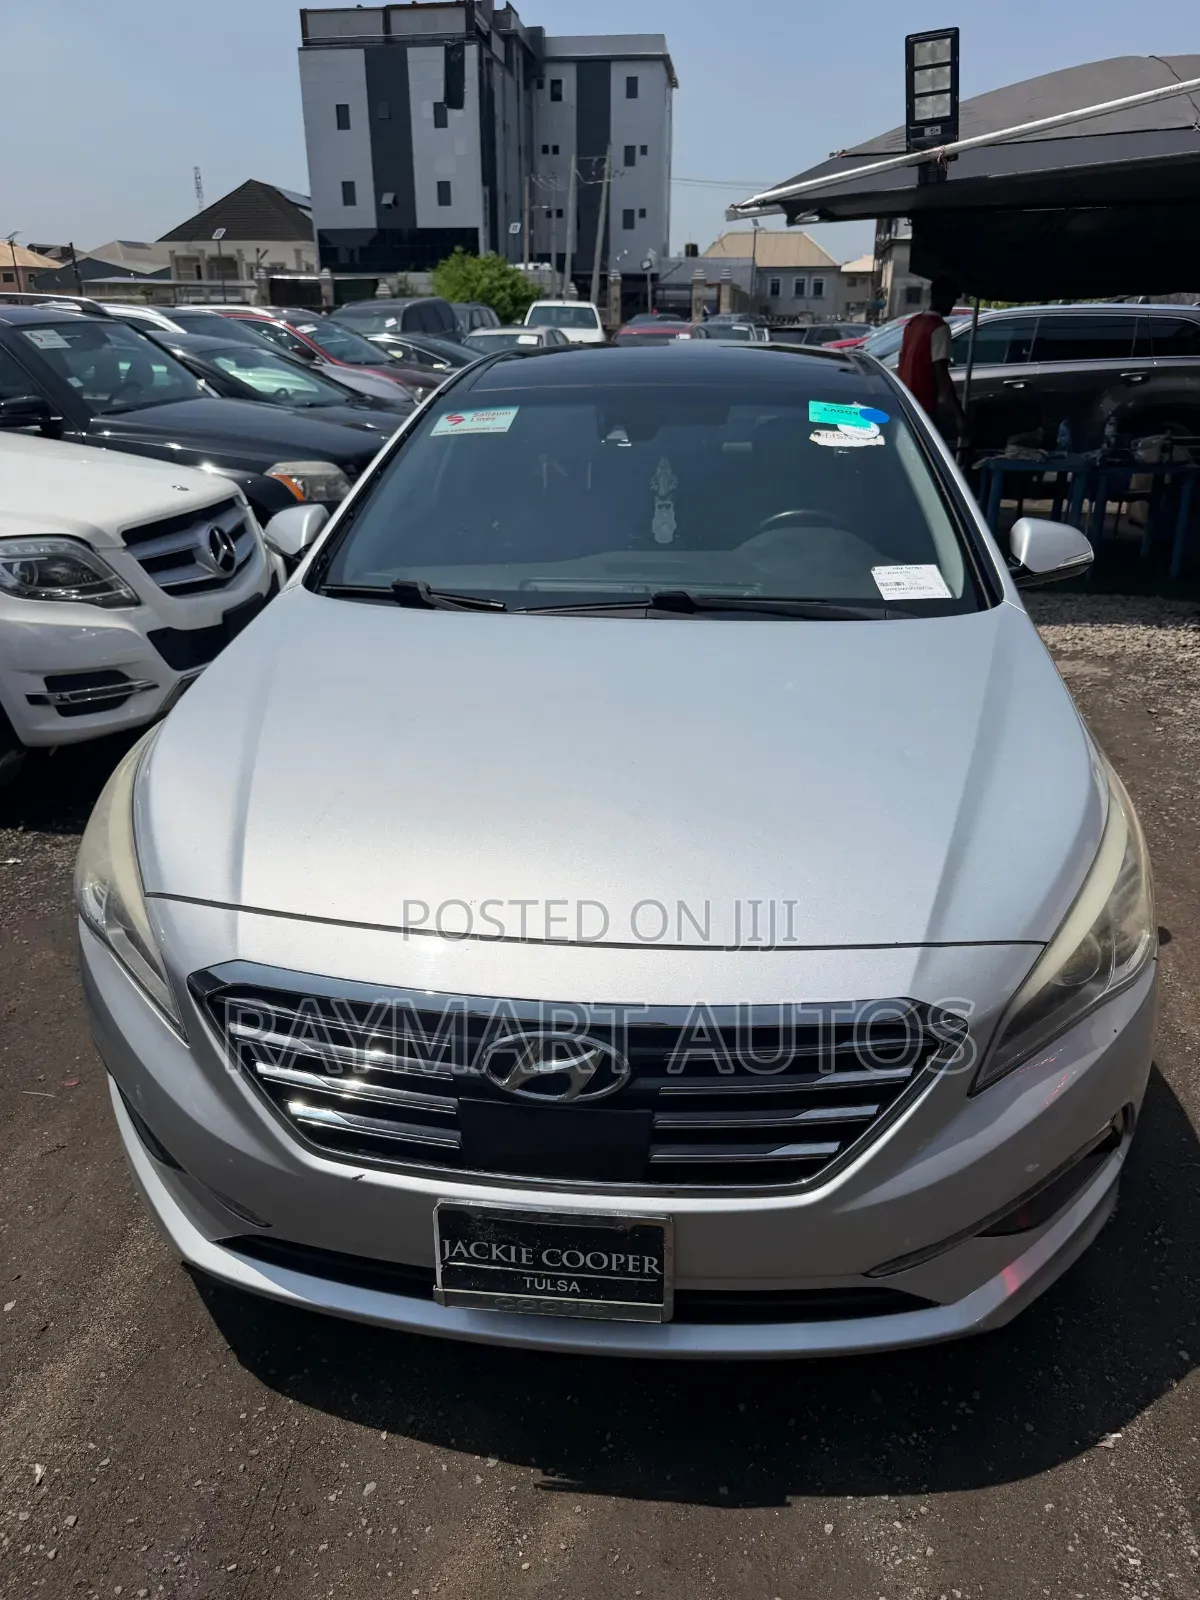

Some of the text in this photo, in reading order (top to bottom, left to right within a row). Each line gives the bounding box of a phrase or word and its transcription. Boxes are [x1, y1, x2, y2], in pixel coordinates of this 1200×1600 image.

[442, 1239, 663, 1275] JACKIE COOPER
[522, 1276, 581, 1293] TULSA
